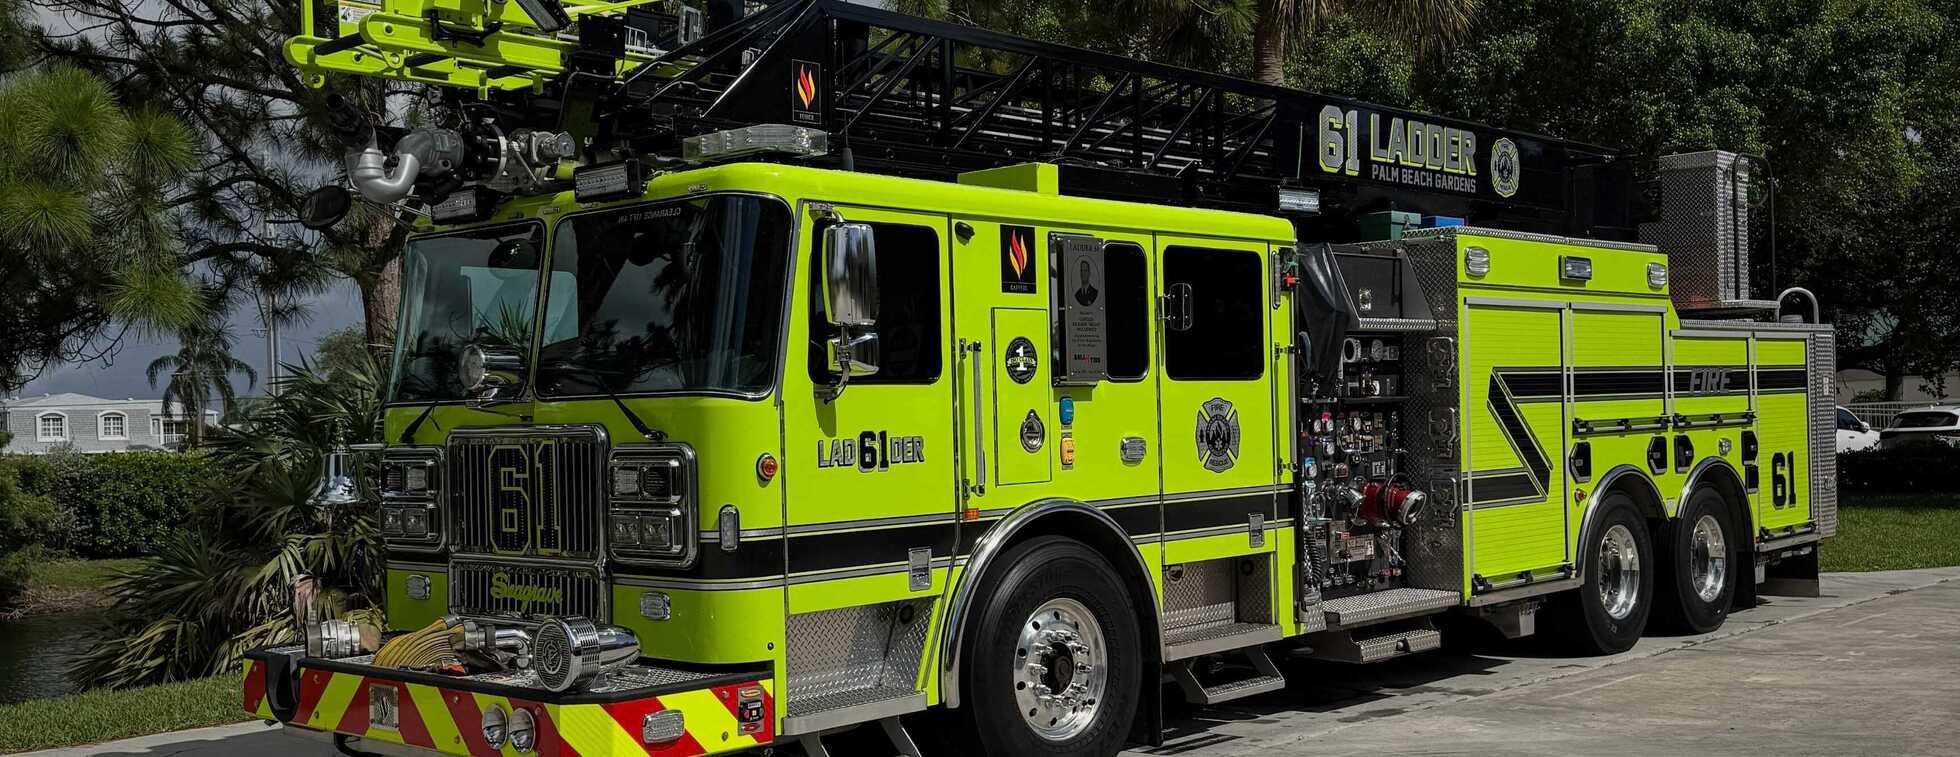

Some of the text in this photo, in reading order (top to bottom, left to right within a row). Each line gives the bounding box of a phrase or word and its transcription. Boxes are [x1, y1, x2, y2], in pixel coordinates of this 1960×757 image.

[1319, 104, 1477, 176] 61 LADDER
[1371, 163, 1477, 193] PALM BEACH GARDENS
[1690, 367, 1731, 394] FIRE
[488, 440, 561, 555] 61
[1772, 450, 1797, 510] 61
